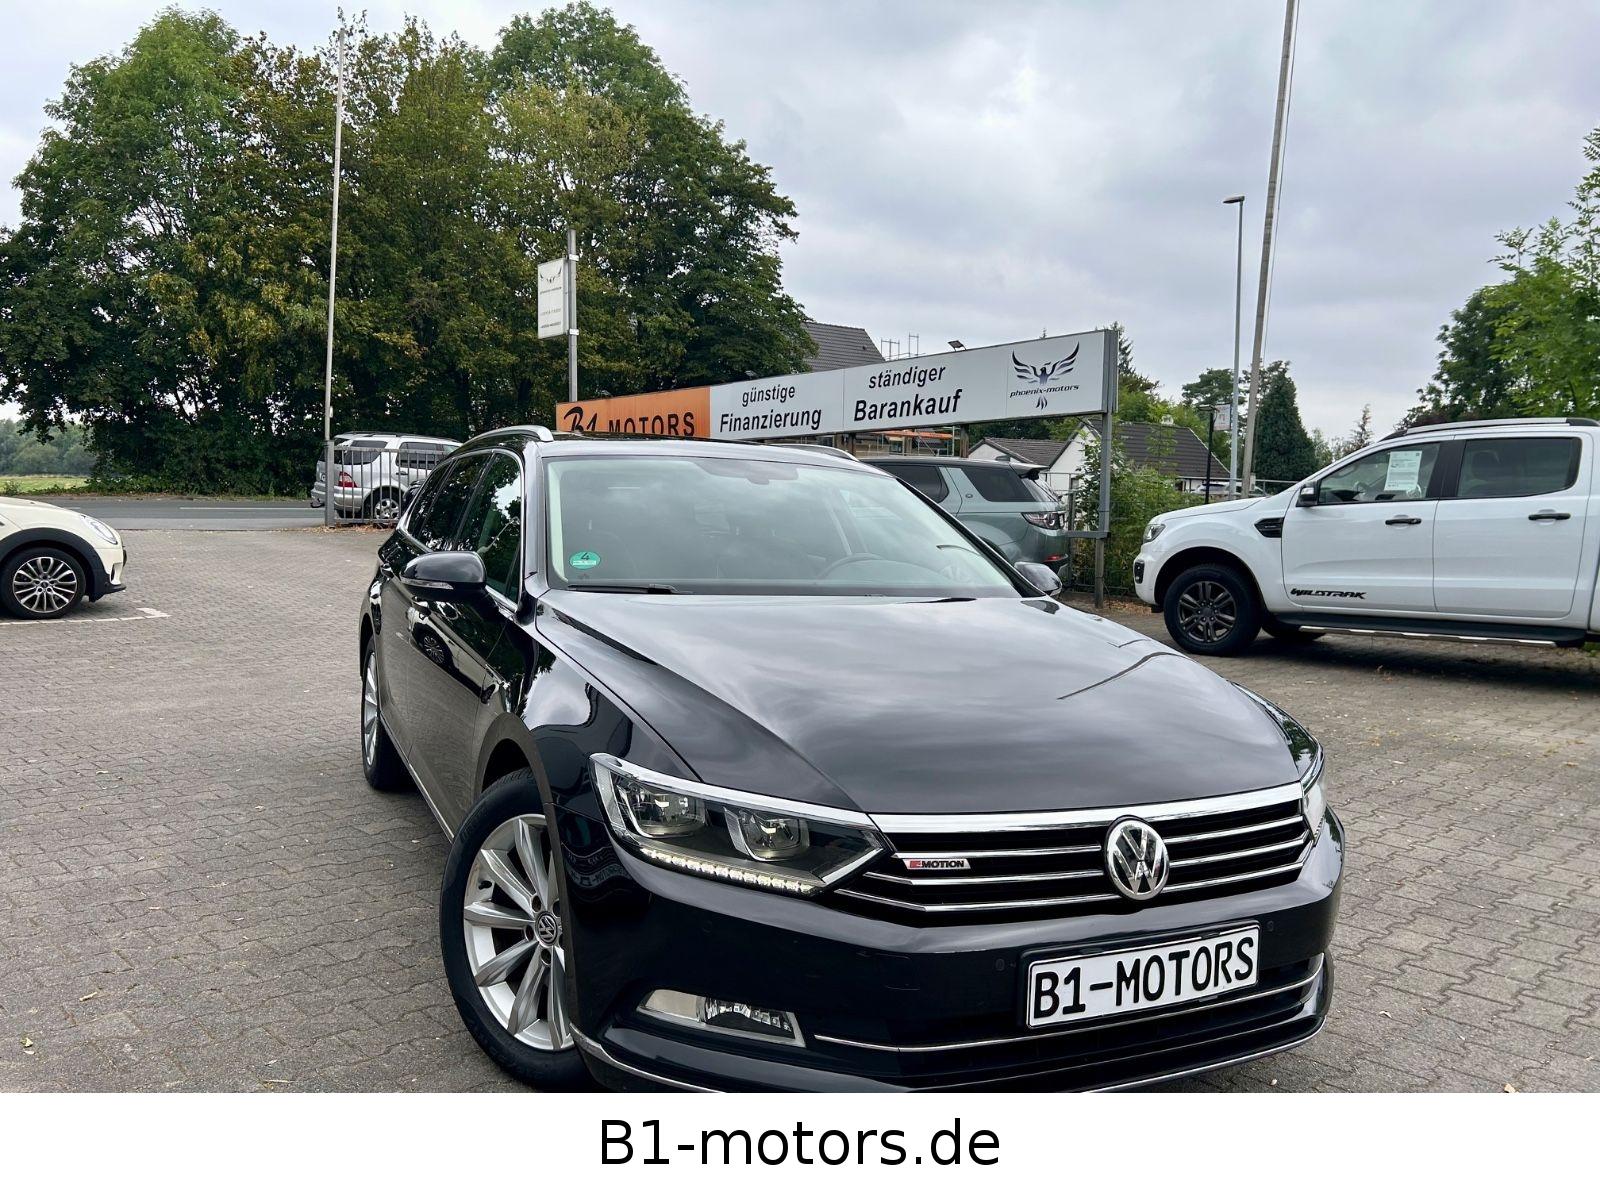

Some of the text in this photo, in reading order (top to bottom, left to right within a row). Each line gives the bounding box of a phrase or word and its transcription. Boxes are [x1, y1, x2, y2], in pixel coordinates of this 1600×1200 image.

[868, 364, 946, 389] ständiger
[742, 384, 796, 407] günstige
[1009, 384, 1080, 398] phoenix-motors
[853, 388, 963, 422] Barankauf
[608, 411, 695, 437] MOTORS
[719, 408, 822, 433] Finanzierung
[1289, 588, 1368, 600] WILDTRAK
[1033, 936, 1255, 1020] B1-MOTORS
